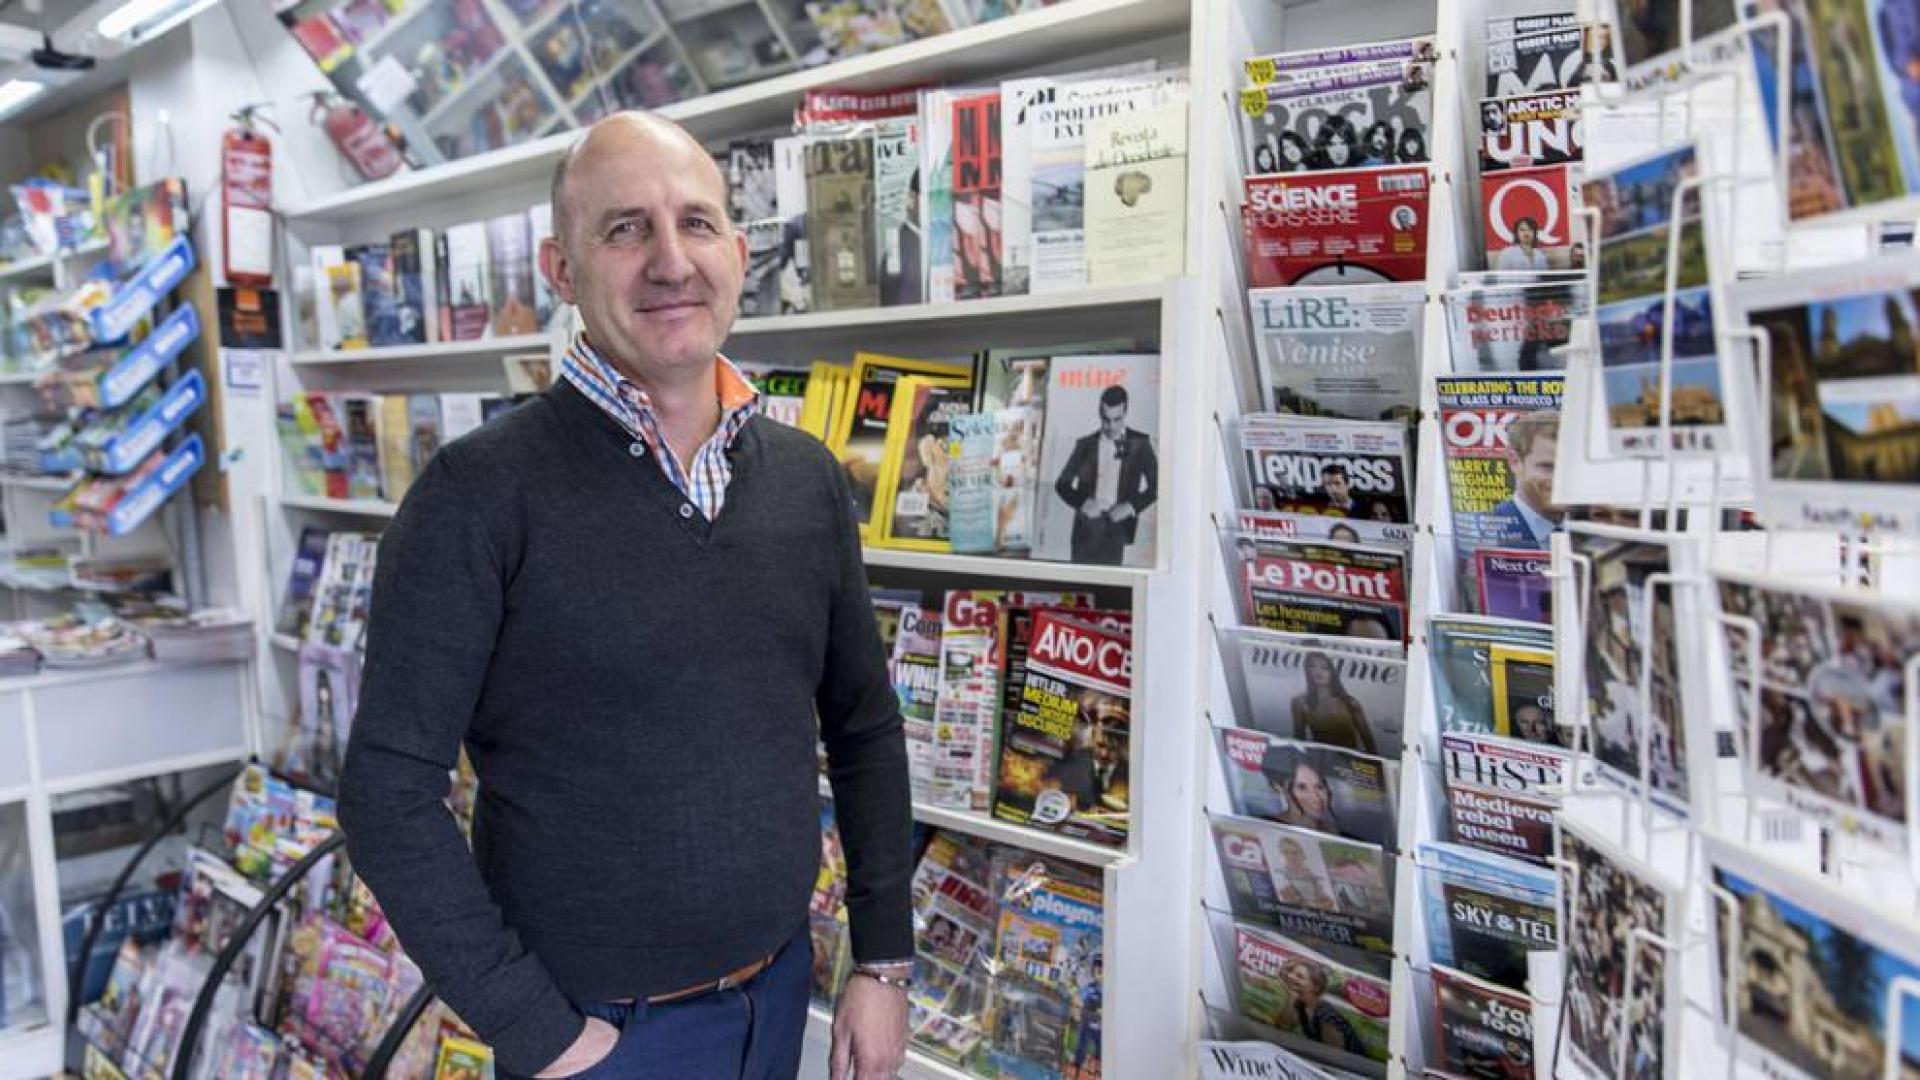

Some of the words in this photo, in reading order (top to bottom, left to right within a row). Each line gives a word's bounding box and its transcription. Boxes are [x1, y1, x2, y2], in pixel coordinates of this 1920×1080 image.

[1507, 96, 1563, 113] ARCTIC
[1488, 178, 1562, 246] Q
[1273, 336, 1375, 365] Venise
[1439, 381, 1513, 396] CELEBRATING
[1516, 381, 1537, 396] THE
[1446, 412, 1520, 448] OK
[1248, 560, 1285, 584] Le
[1289, 560, 1392, 600] Point
[1491, 558, 1524, 573] Next
[1251, 645, 1399, 685] mame
[1455, 809, 1514, 830] rebel
[1457, 823, 1528, 849] queen
[1452, 901, 1494, 926] SKY
[1496, 913, 1516, 932] &
[1210, 1047, 1272, 1078] Wine
